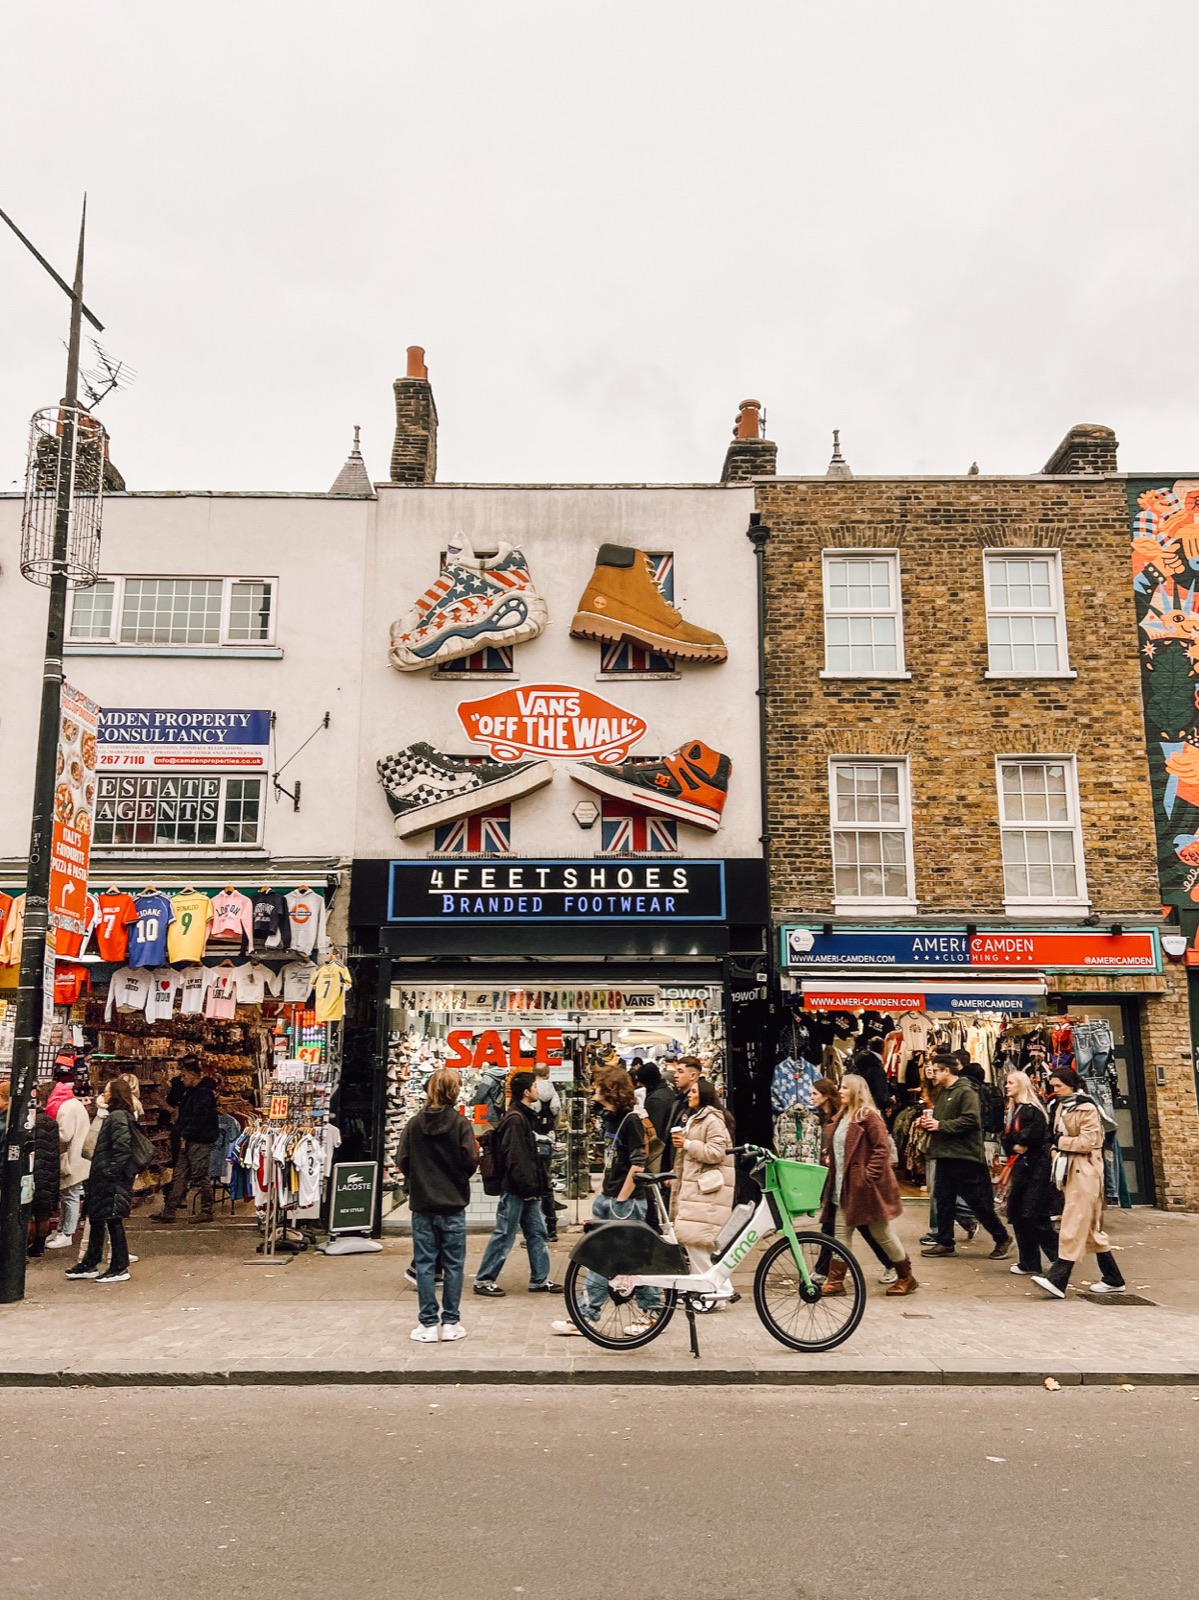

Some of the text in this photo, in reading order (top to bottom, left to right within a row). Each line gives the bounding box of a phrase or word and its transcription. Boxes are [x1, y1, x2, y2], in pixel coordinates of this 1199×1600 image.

[515, 691, 581, 716] VANS
[154, 713, 251, 727] PROPERTY
[97, 728, 228, 742] CONSULTANCY
[470, 713, 637, 749] "OFF THE WALL"
[101, 756, 120, 764] 267
[123, 756, 145, 764] 7110
[100, 778, 218, 797] ESTATE
[98, 801, 215, 820] AGENTS
[564, 896, 676, 912] FOOTWEAR
[103, 914, 117, 939] 7
[136, 918, 159, 943] 10
[181, 912, 193, 936] 9
[971, 938, 1034, 952] CAMDEN
[791, 954, 896, 963] WWW.AMERI-CAMDEN.COM
[943, 954, 999, 962] CLOTHING
[1084, 956, 1152, 965] @AMERICAMDEN
[323, 980, 331, 999] 7
[622, 994, 655, 1007] VANS
[809, 998, 1023, 1008] WWW.AMERI-CAMDEN.COM @AMERICAMDEN
[299, 1048, 317, 1063] £1
[445, 1028, 562, 1068] SALE
[272, 1098, 287, 1115] £15
[337, 1182, 372, 1192] LACOSTE
